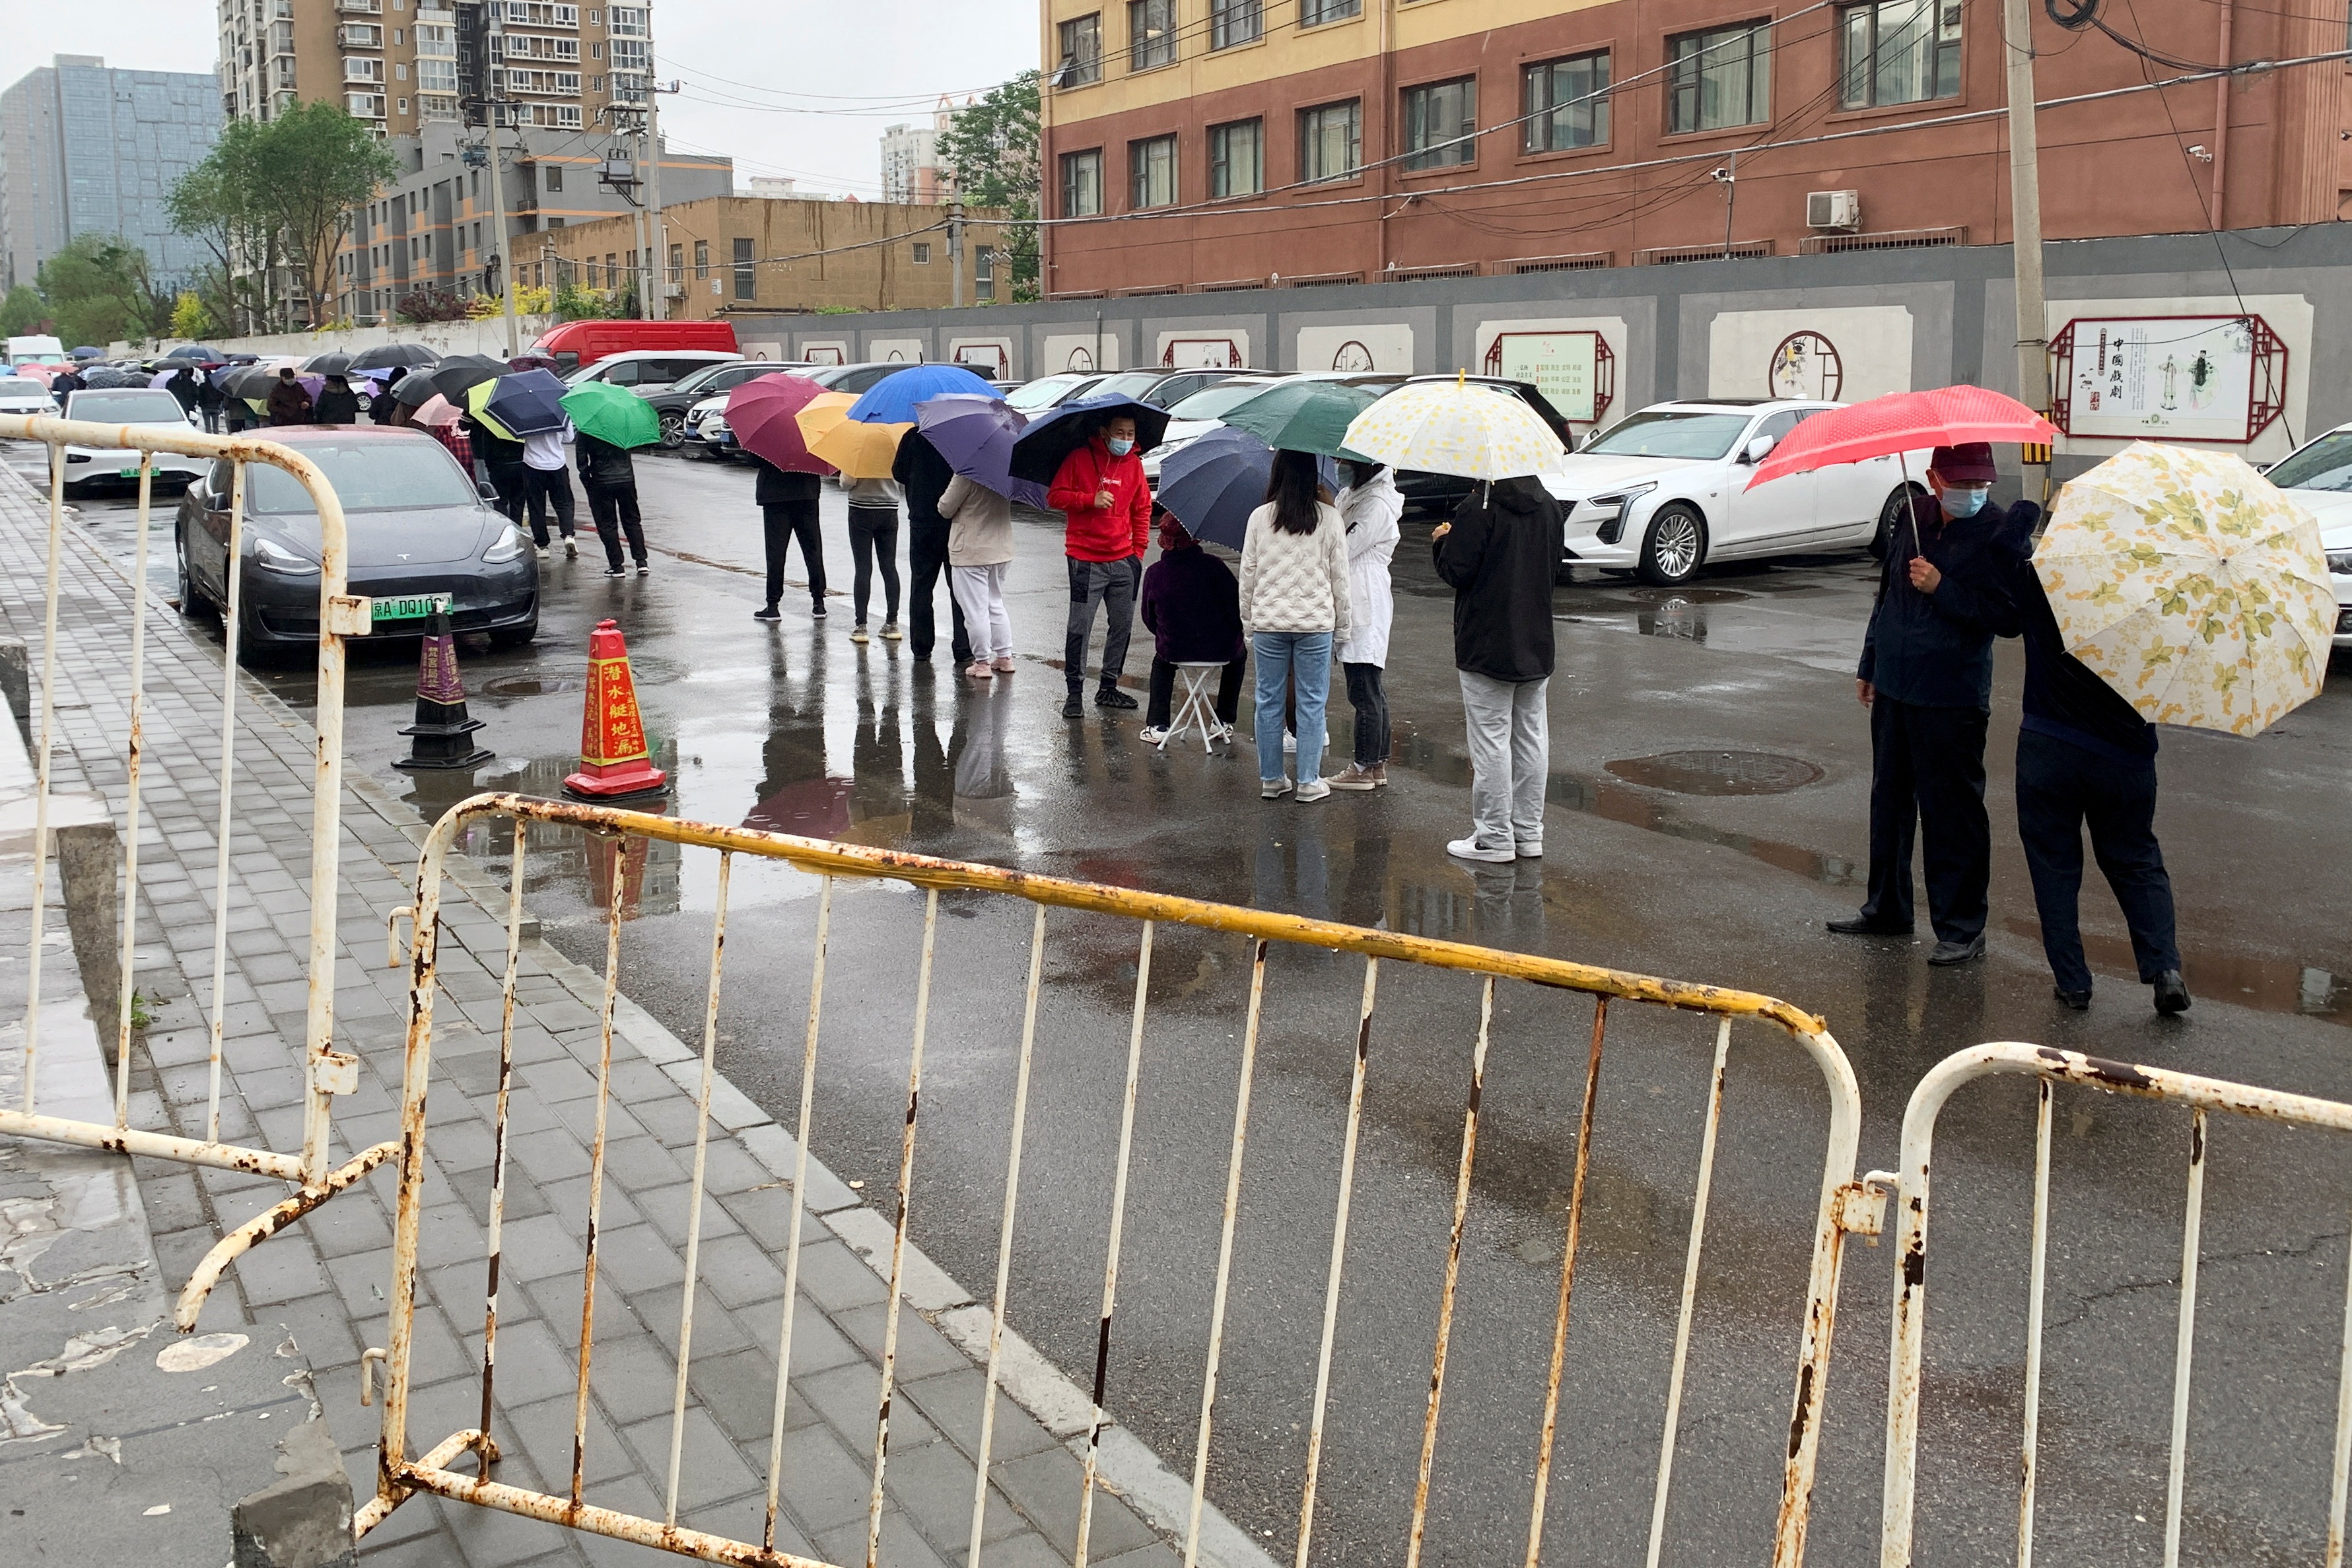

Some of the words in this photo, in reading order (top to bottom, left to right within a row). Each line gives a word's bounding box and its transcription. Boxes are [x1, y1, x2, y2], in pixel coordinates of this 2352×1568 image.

[604, 664, 633, 756] 潜水艇地漏
